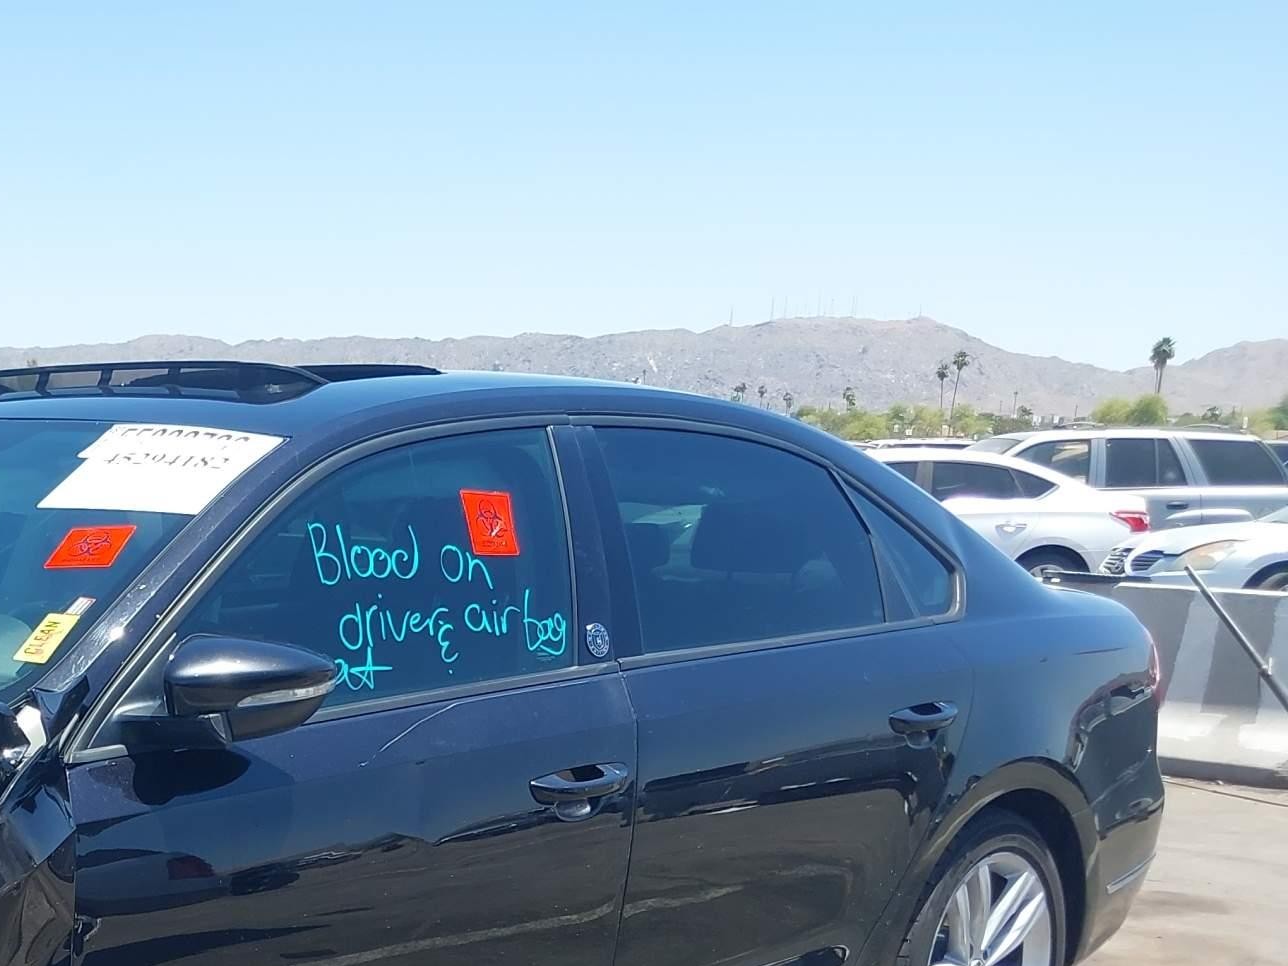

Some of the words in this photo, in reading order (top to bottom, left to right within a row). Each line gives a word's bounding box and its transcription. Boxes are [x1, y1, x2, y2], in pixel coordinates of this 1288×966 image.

[307, 522, 419, 585] Blood
[23, 620, 61, 655] CLEAN
[339, 593, 449, 650] driver
